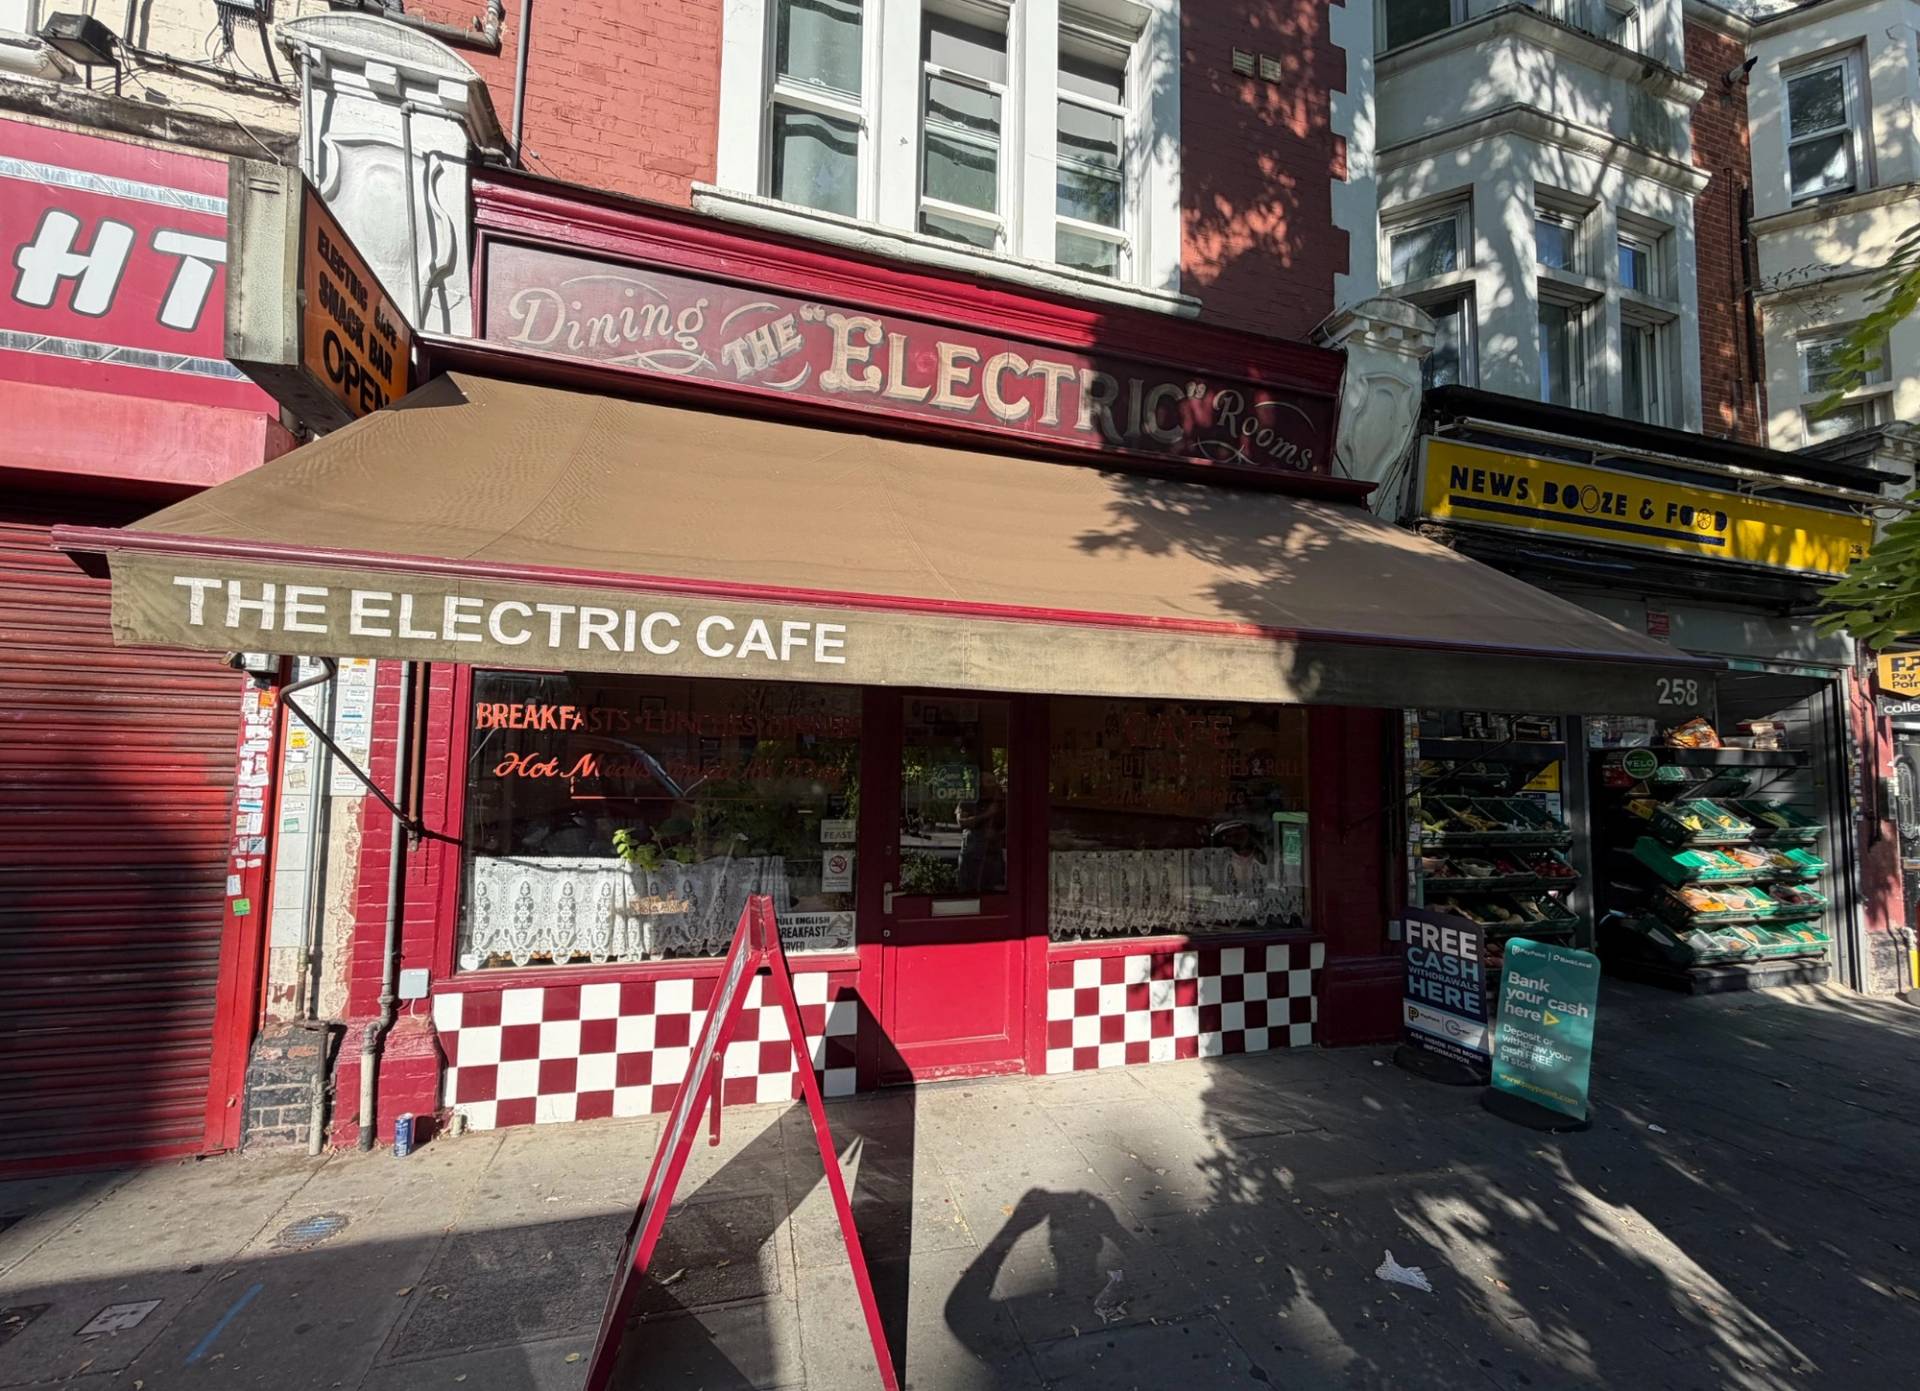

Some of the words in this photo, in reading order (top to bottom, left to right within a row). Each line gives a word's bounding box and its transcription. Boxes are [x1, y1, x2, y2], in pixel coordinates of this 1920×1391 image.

[318, 225, 368, 312] ELECTRIC
[318, 270, 365, 353] SNACK
[508, 287, 709, 351] Dining
[721, 313, 803, 379] THE
[323, 329, 390, 412] OPEN
[369, 331, 394, 385] BAR
[1450, 465, 1529, 499] NEWS
[1543, 481, 1628, 516] BOOZE
[1639, 498, 1655, 520] &
[1666, 503, 1728, 532] FOOD
[173, 575, 328, 634] THE
[348, 588, 680, 656] ELECTRIC
[696, 615, 846, 664] CAFE
[1656, 678, 1698, 706] 258
[1892, 673, 1916, 682] Pay
[475, 702, 632, 734] BREAKFASTS
[493, 752, 559, 778] Hot
[937, 788, 975, 800] OPEN
[778, 917, 793, 927] ULL
[795, 916, 830, 925] ENGLISH
[781, 925, 828, 938] REAKFAST
[1406, 919, 1478, 962] FREE
[1407, 946, 1479, 982] CASH
[1408, 965, 1480, 992] WITHDRAWALS
[1408, 974, 1481, 1014] HERE
[1508, 970, 1550, 993] Bank
[1504, 1000, 1542, 1022] here
[1506, 987, 1545, 1005] your
[1548, 998, 1589, 1018] cash
[1502, 1035, 1548, 1055] withdraw
[1549, 1049, 1574, 1063] your
[1503, 1023, 1542, 1044] Deposit
[1543, 1038, 1555, 1046] or
[1501, 1044, 1524, 1059] cash
[1525, 1051, 1553, 1068] FREE
